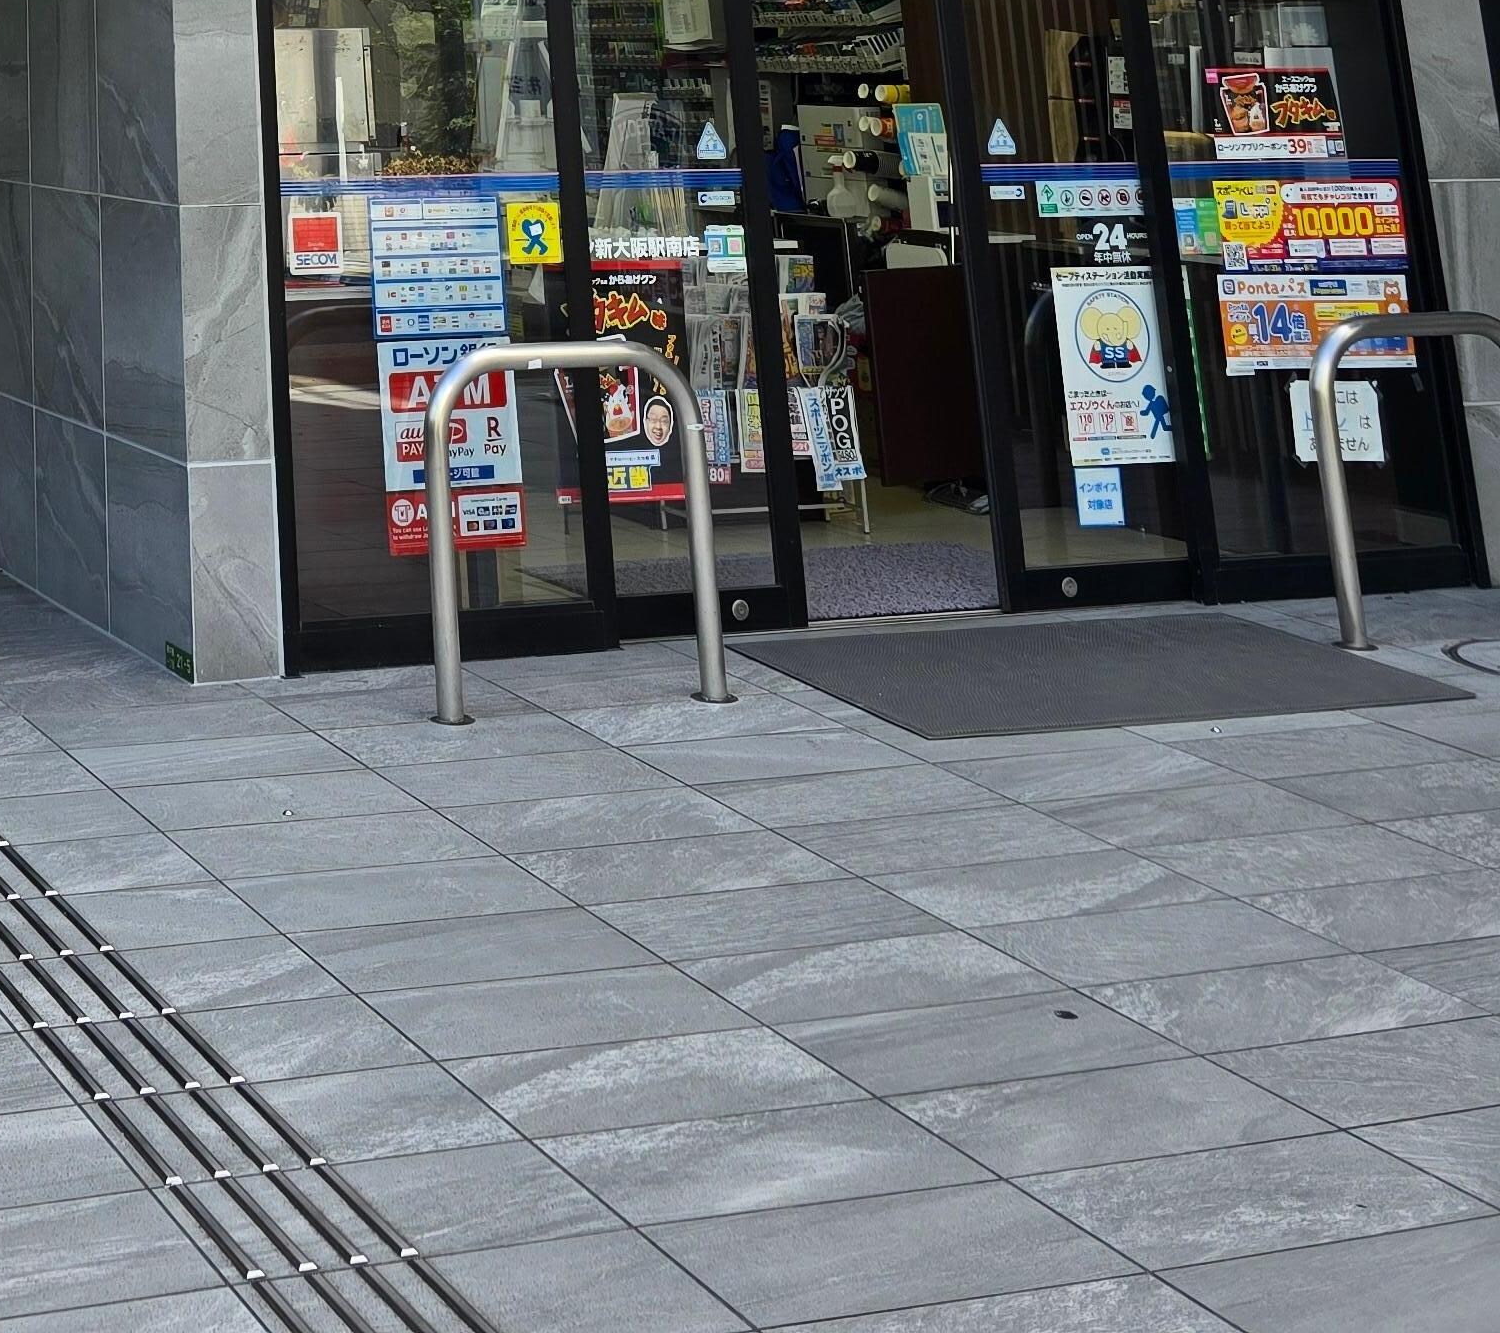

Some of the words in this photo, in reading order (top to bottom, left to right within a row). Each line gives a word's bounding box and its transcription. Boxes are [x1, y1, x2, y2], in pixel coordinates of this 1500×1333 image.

[1291, 206, 1374, 237] 10,000
[1092, 222, 1128, 251] 24
[589, 236, 700, 259] 新大阪駅南店
[296, 253, 338, 266] SECOM
[1093, 251, 1132, 263] 年中無休
[1237, 277, 1307, 296] Pontaパス
[1104, 346, 1125, 359] SS
[407, 372, 491, 408] AM
[830, 398, 853, 449] POG
[402, 442, 424, 456] PAY
[484, 444, 507, 456] Pay
[1079, 482, 1118, 493] インボイス
